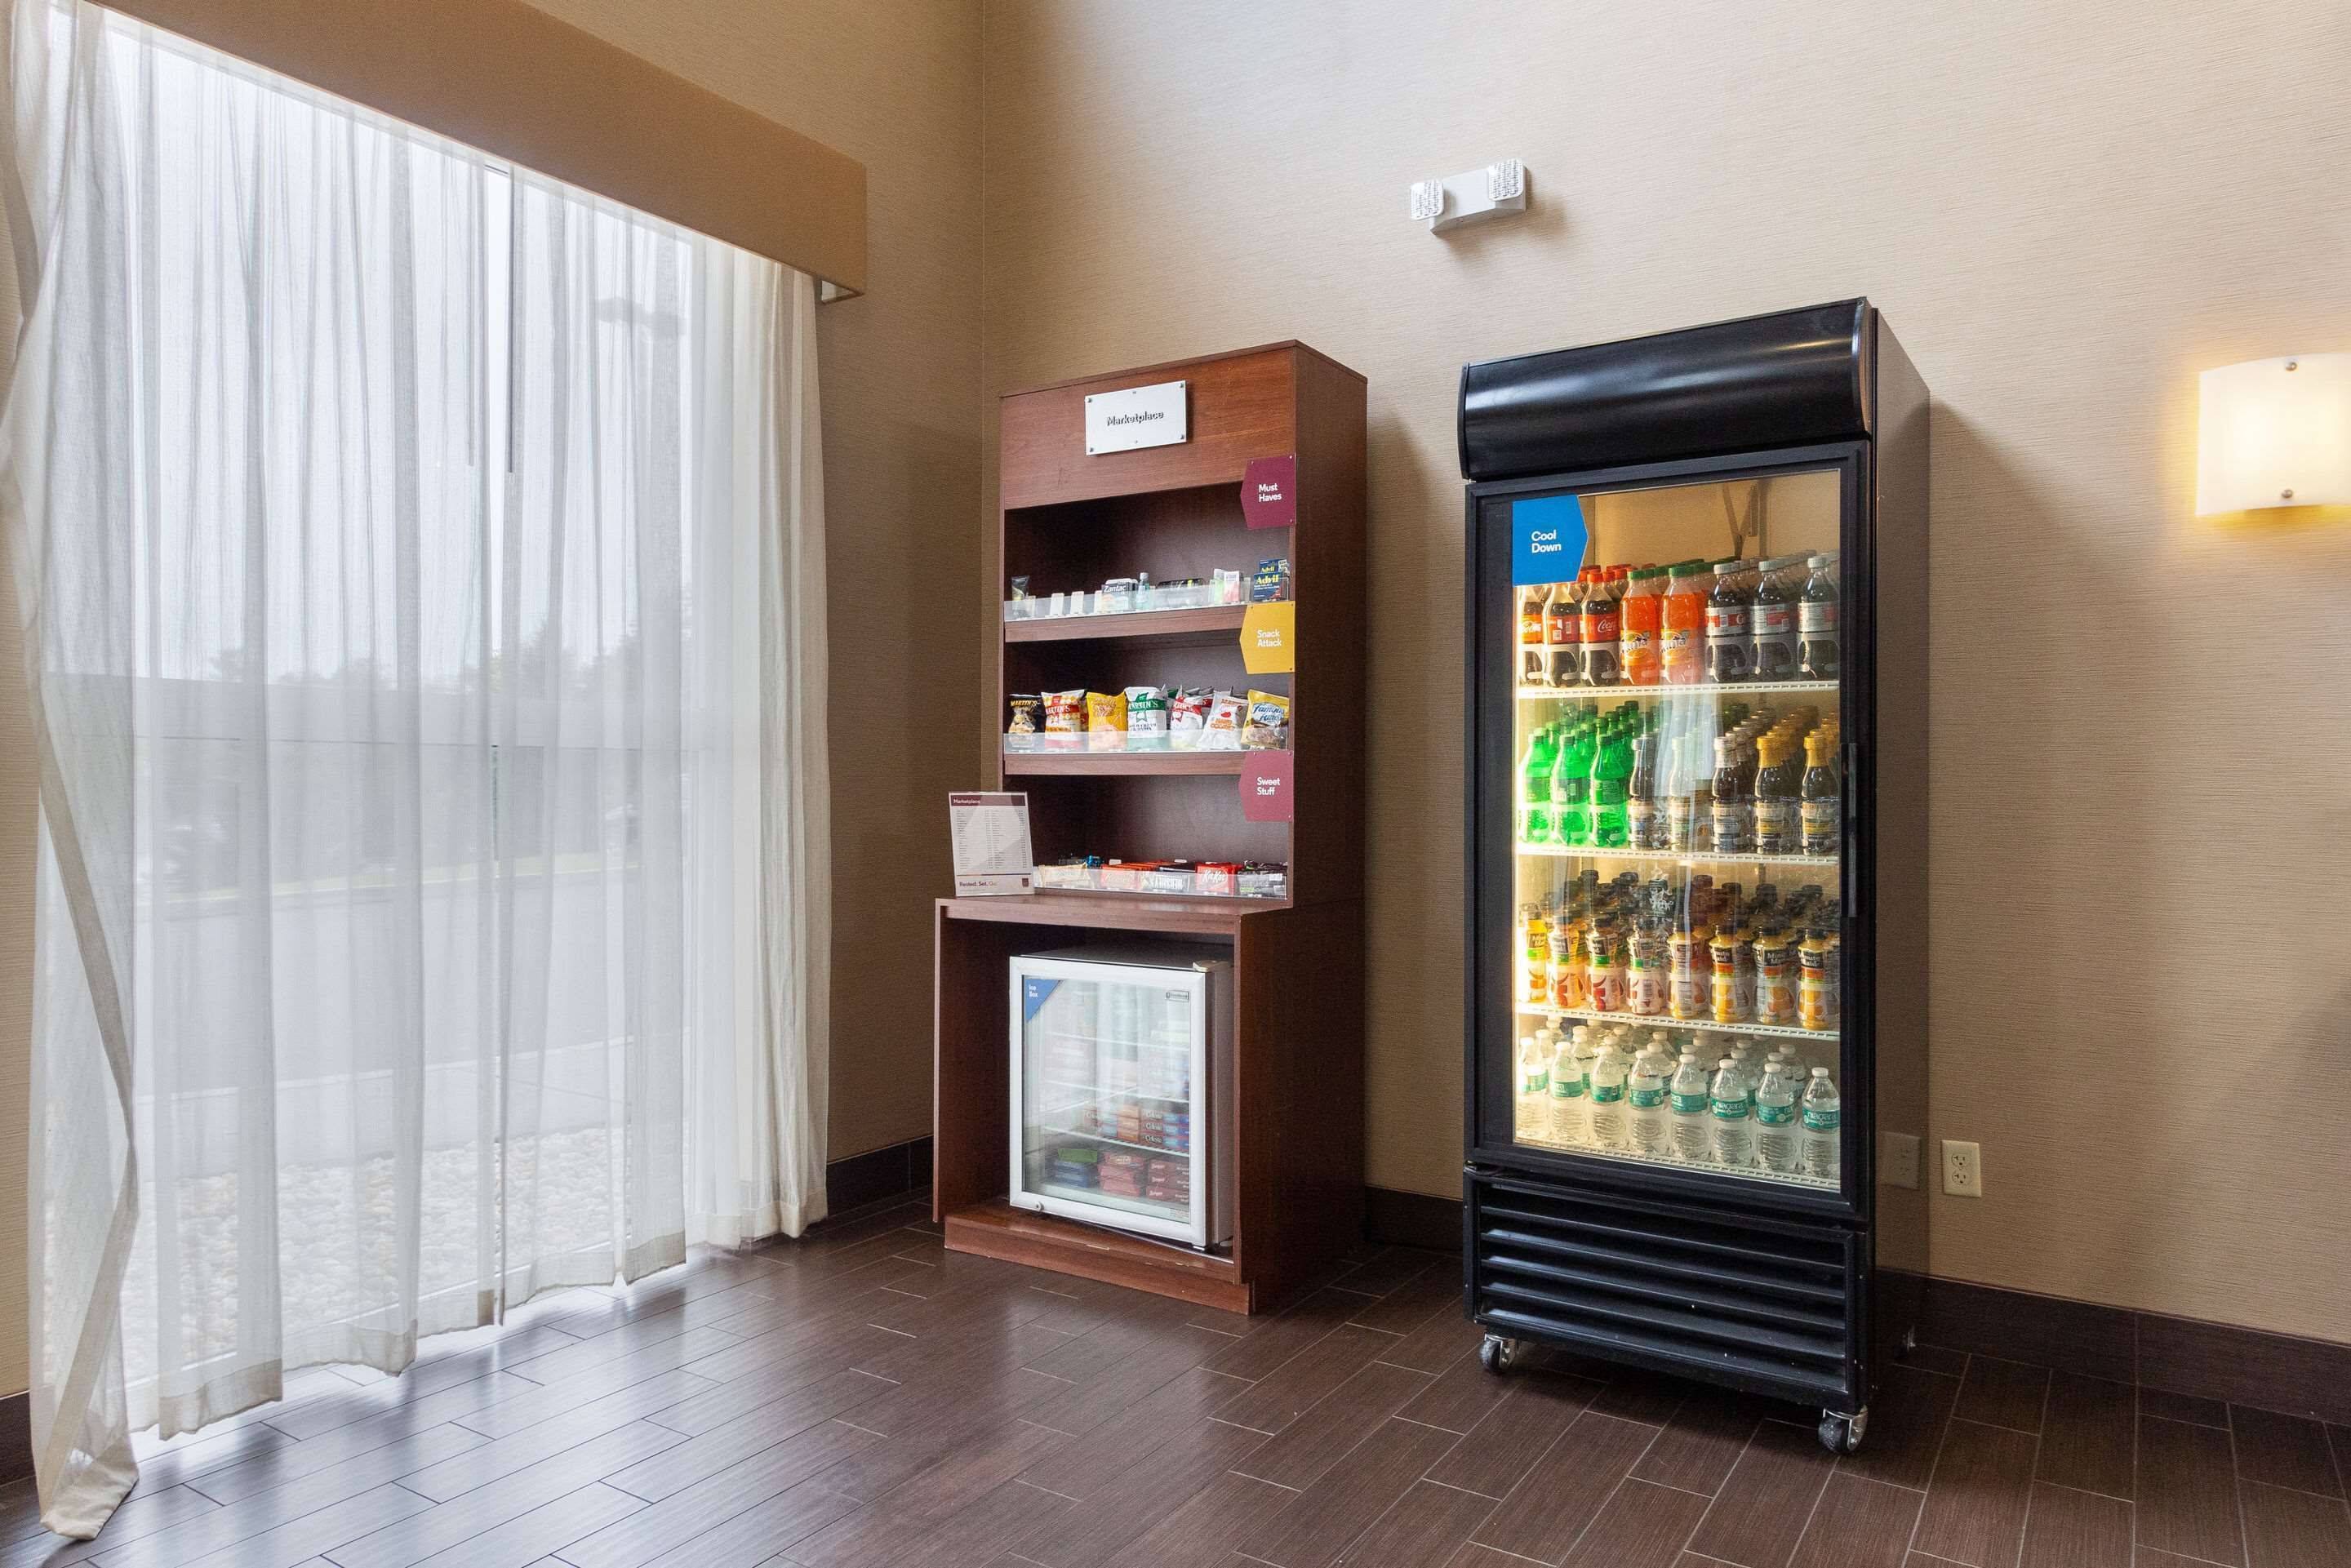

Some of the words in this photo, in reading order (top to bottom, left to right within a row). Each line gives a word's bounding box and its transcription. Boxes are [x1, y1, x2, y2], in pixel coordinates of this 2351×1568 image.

[1106, 411, 1165, 426] Marketplace
[1258, 482, 1278, 493] Must
[1258, 493, 1282, 503] Haves
[1531, 529, 1557, 542] Cool
[1531, 543, 1562, 553] Down
[1255, 574, 1279, 584] Advil
[1104, 584, 1127, 593] Zantac
[1257, 629, 1281, 638] Snack
[1257, 638, 1282, 647] Attack
[1045, 704, 1071, 716] ARTIN'S
[1253, 704, 1285, 714] Famous
[1257, 776, 1281, 786] Sweet
[1257, 786, 1276, 796] Stuff
